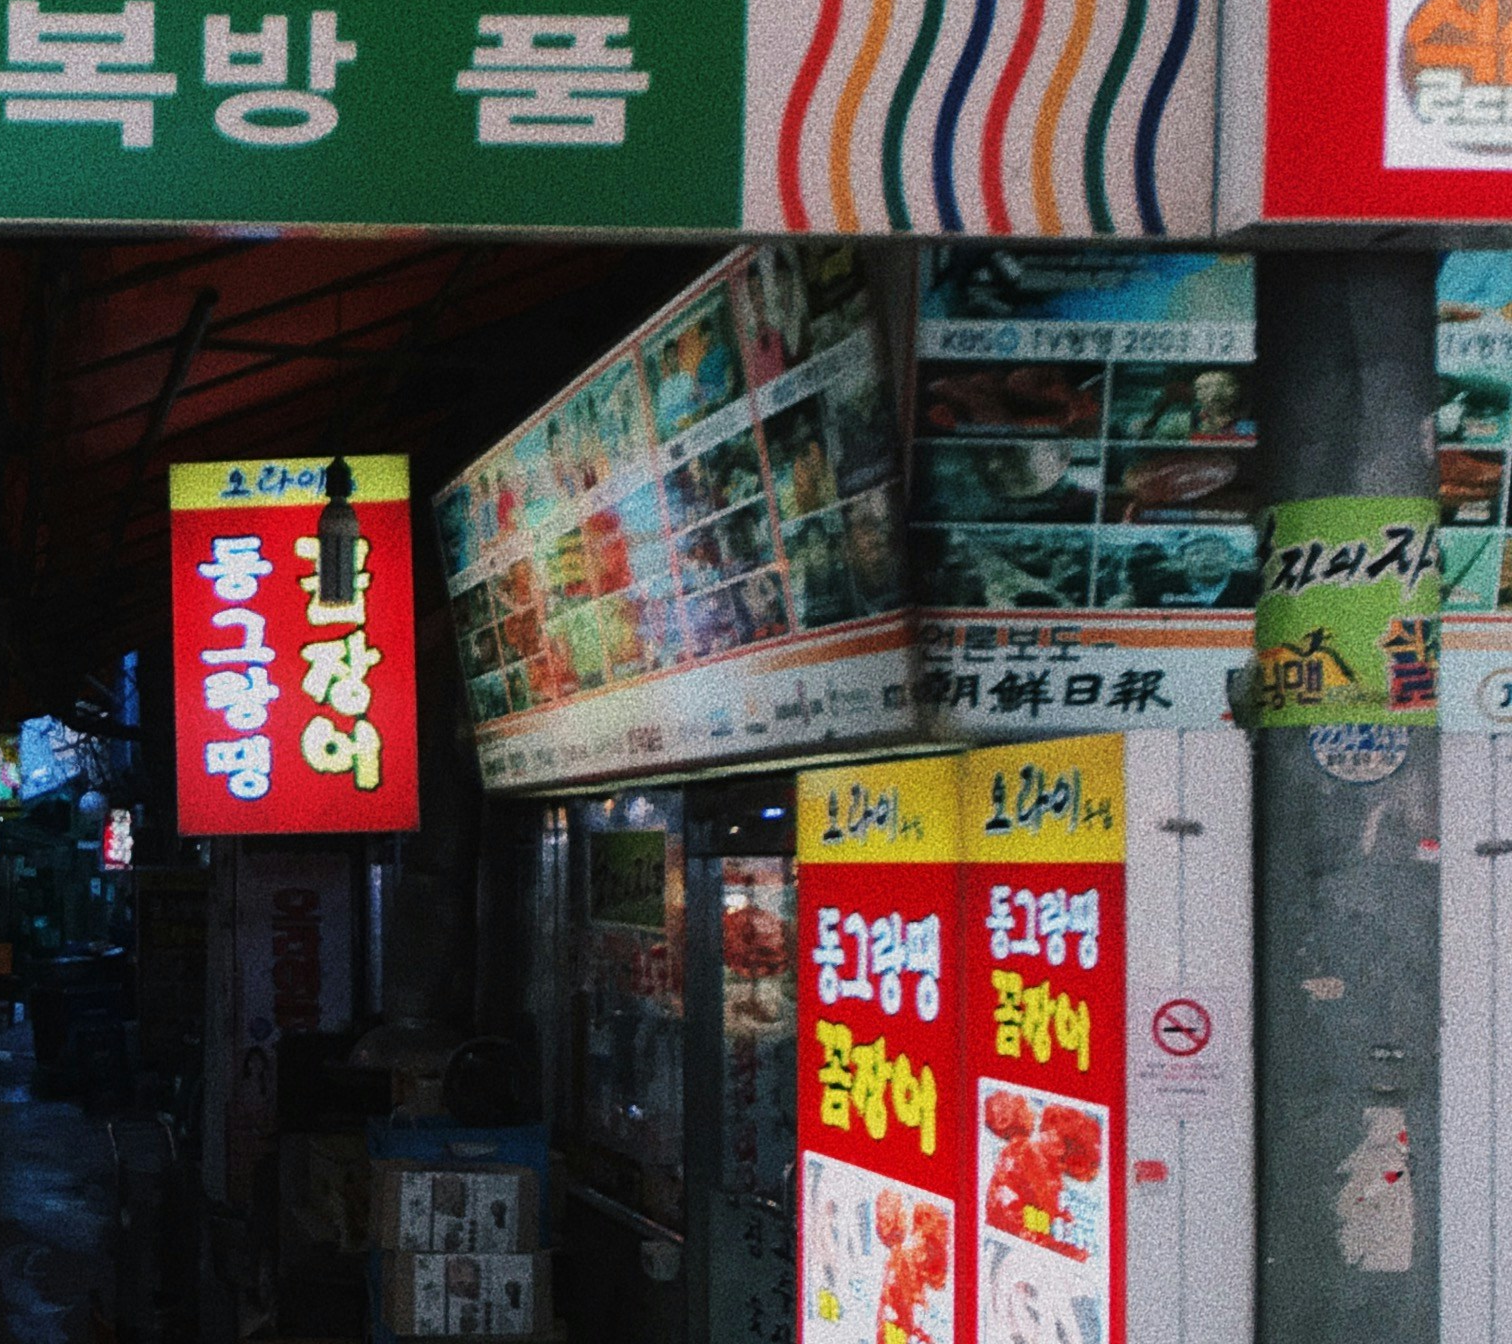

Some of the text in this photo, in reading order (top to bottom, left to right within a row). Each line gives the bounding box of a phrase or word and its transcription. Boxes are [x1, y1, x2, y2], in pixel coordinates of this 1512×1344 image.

[197, 535, 281, 800] 동그랑땡
[812, 907, 940, 1022] 동그랑땡
[985, 884, 1099, 970] 동그랑땡
[991, 968, 1091, 1072] 꼼장어
[816, 1019, 937, 1155] 꼼장어
